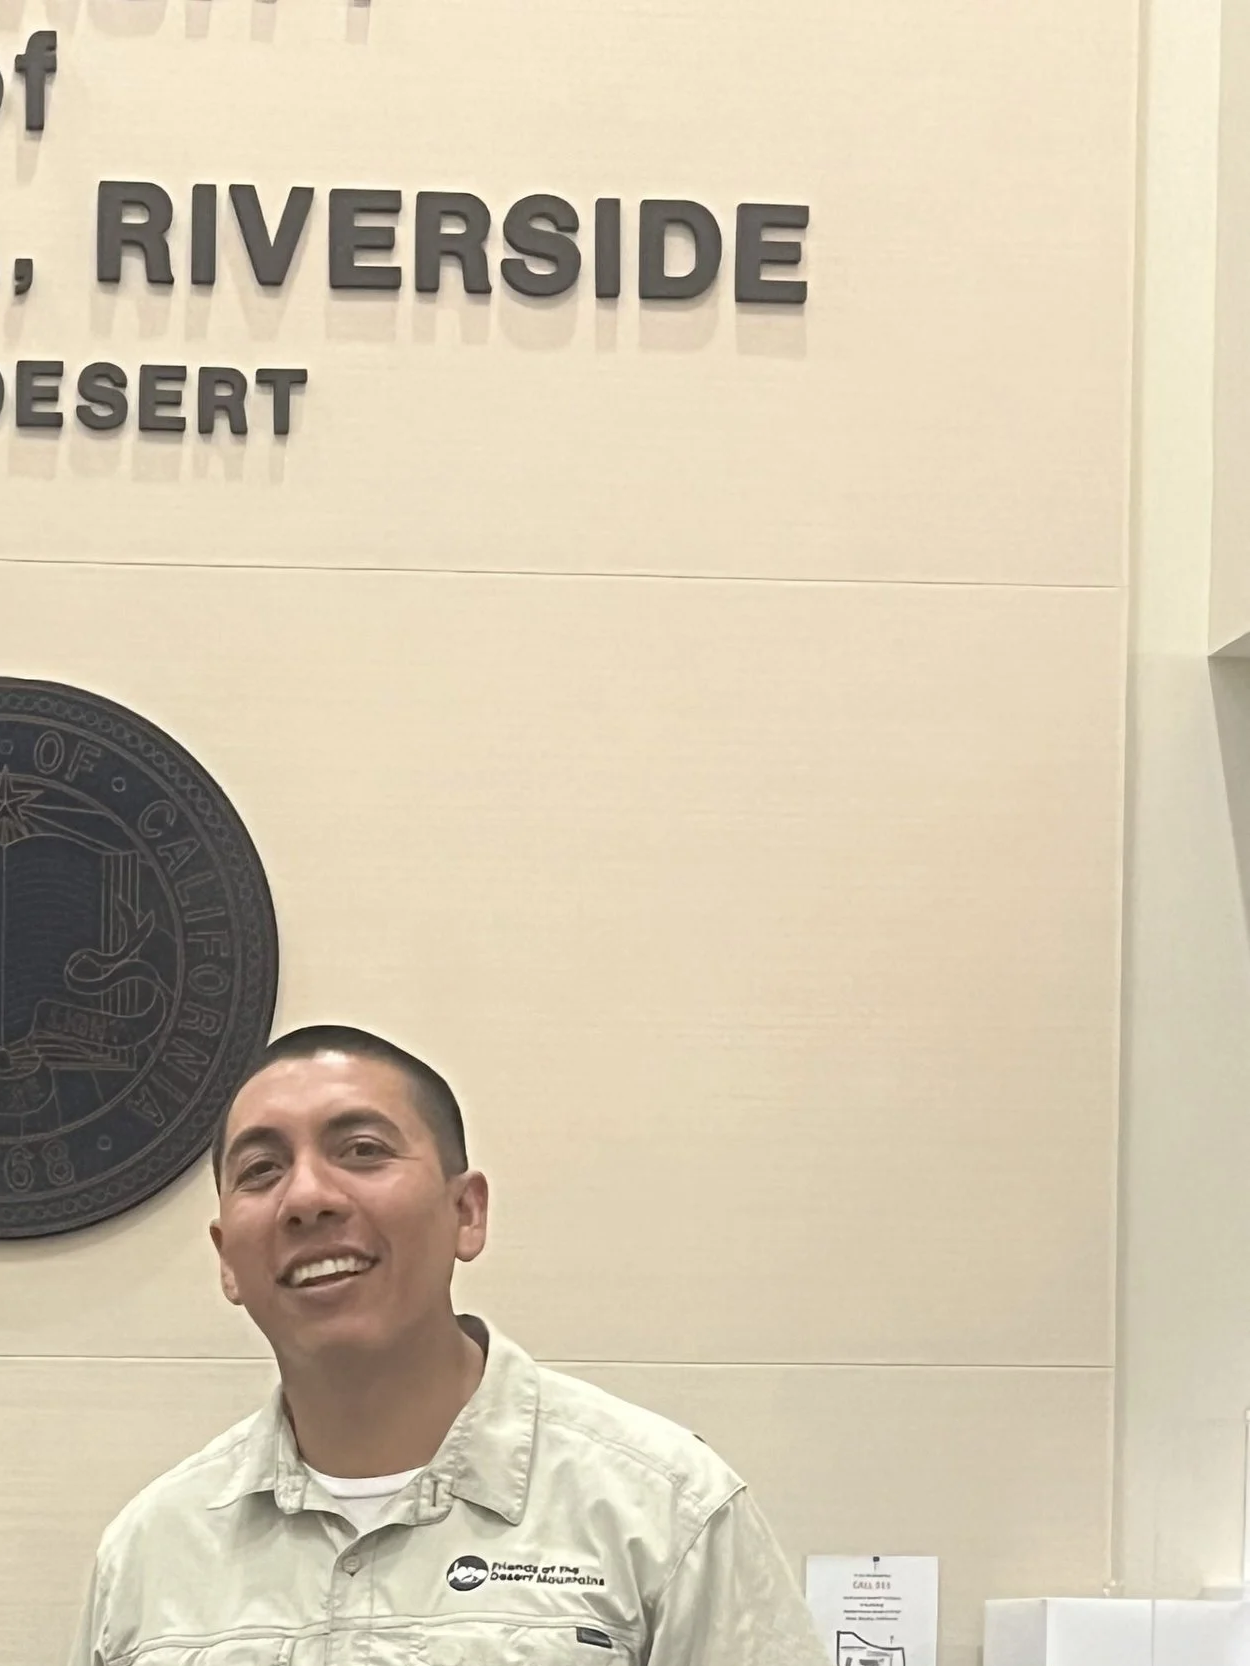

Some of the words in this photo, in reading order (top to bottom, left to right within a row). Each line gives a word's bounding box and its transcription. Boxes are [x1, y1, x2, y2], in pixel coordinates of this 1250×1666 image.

[97, 181, 810, 305] RIVERSIDE
[34, 731, 101, 781] OF
[125, 800, 232, 1127] CALIFORNIA
